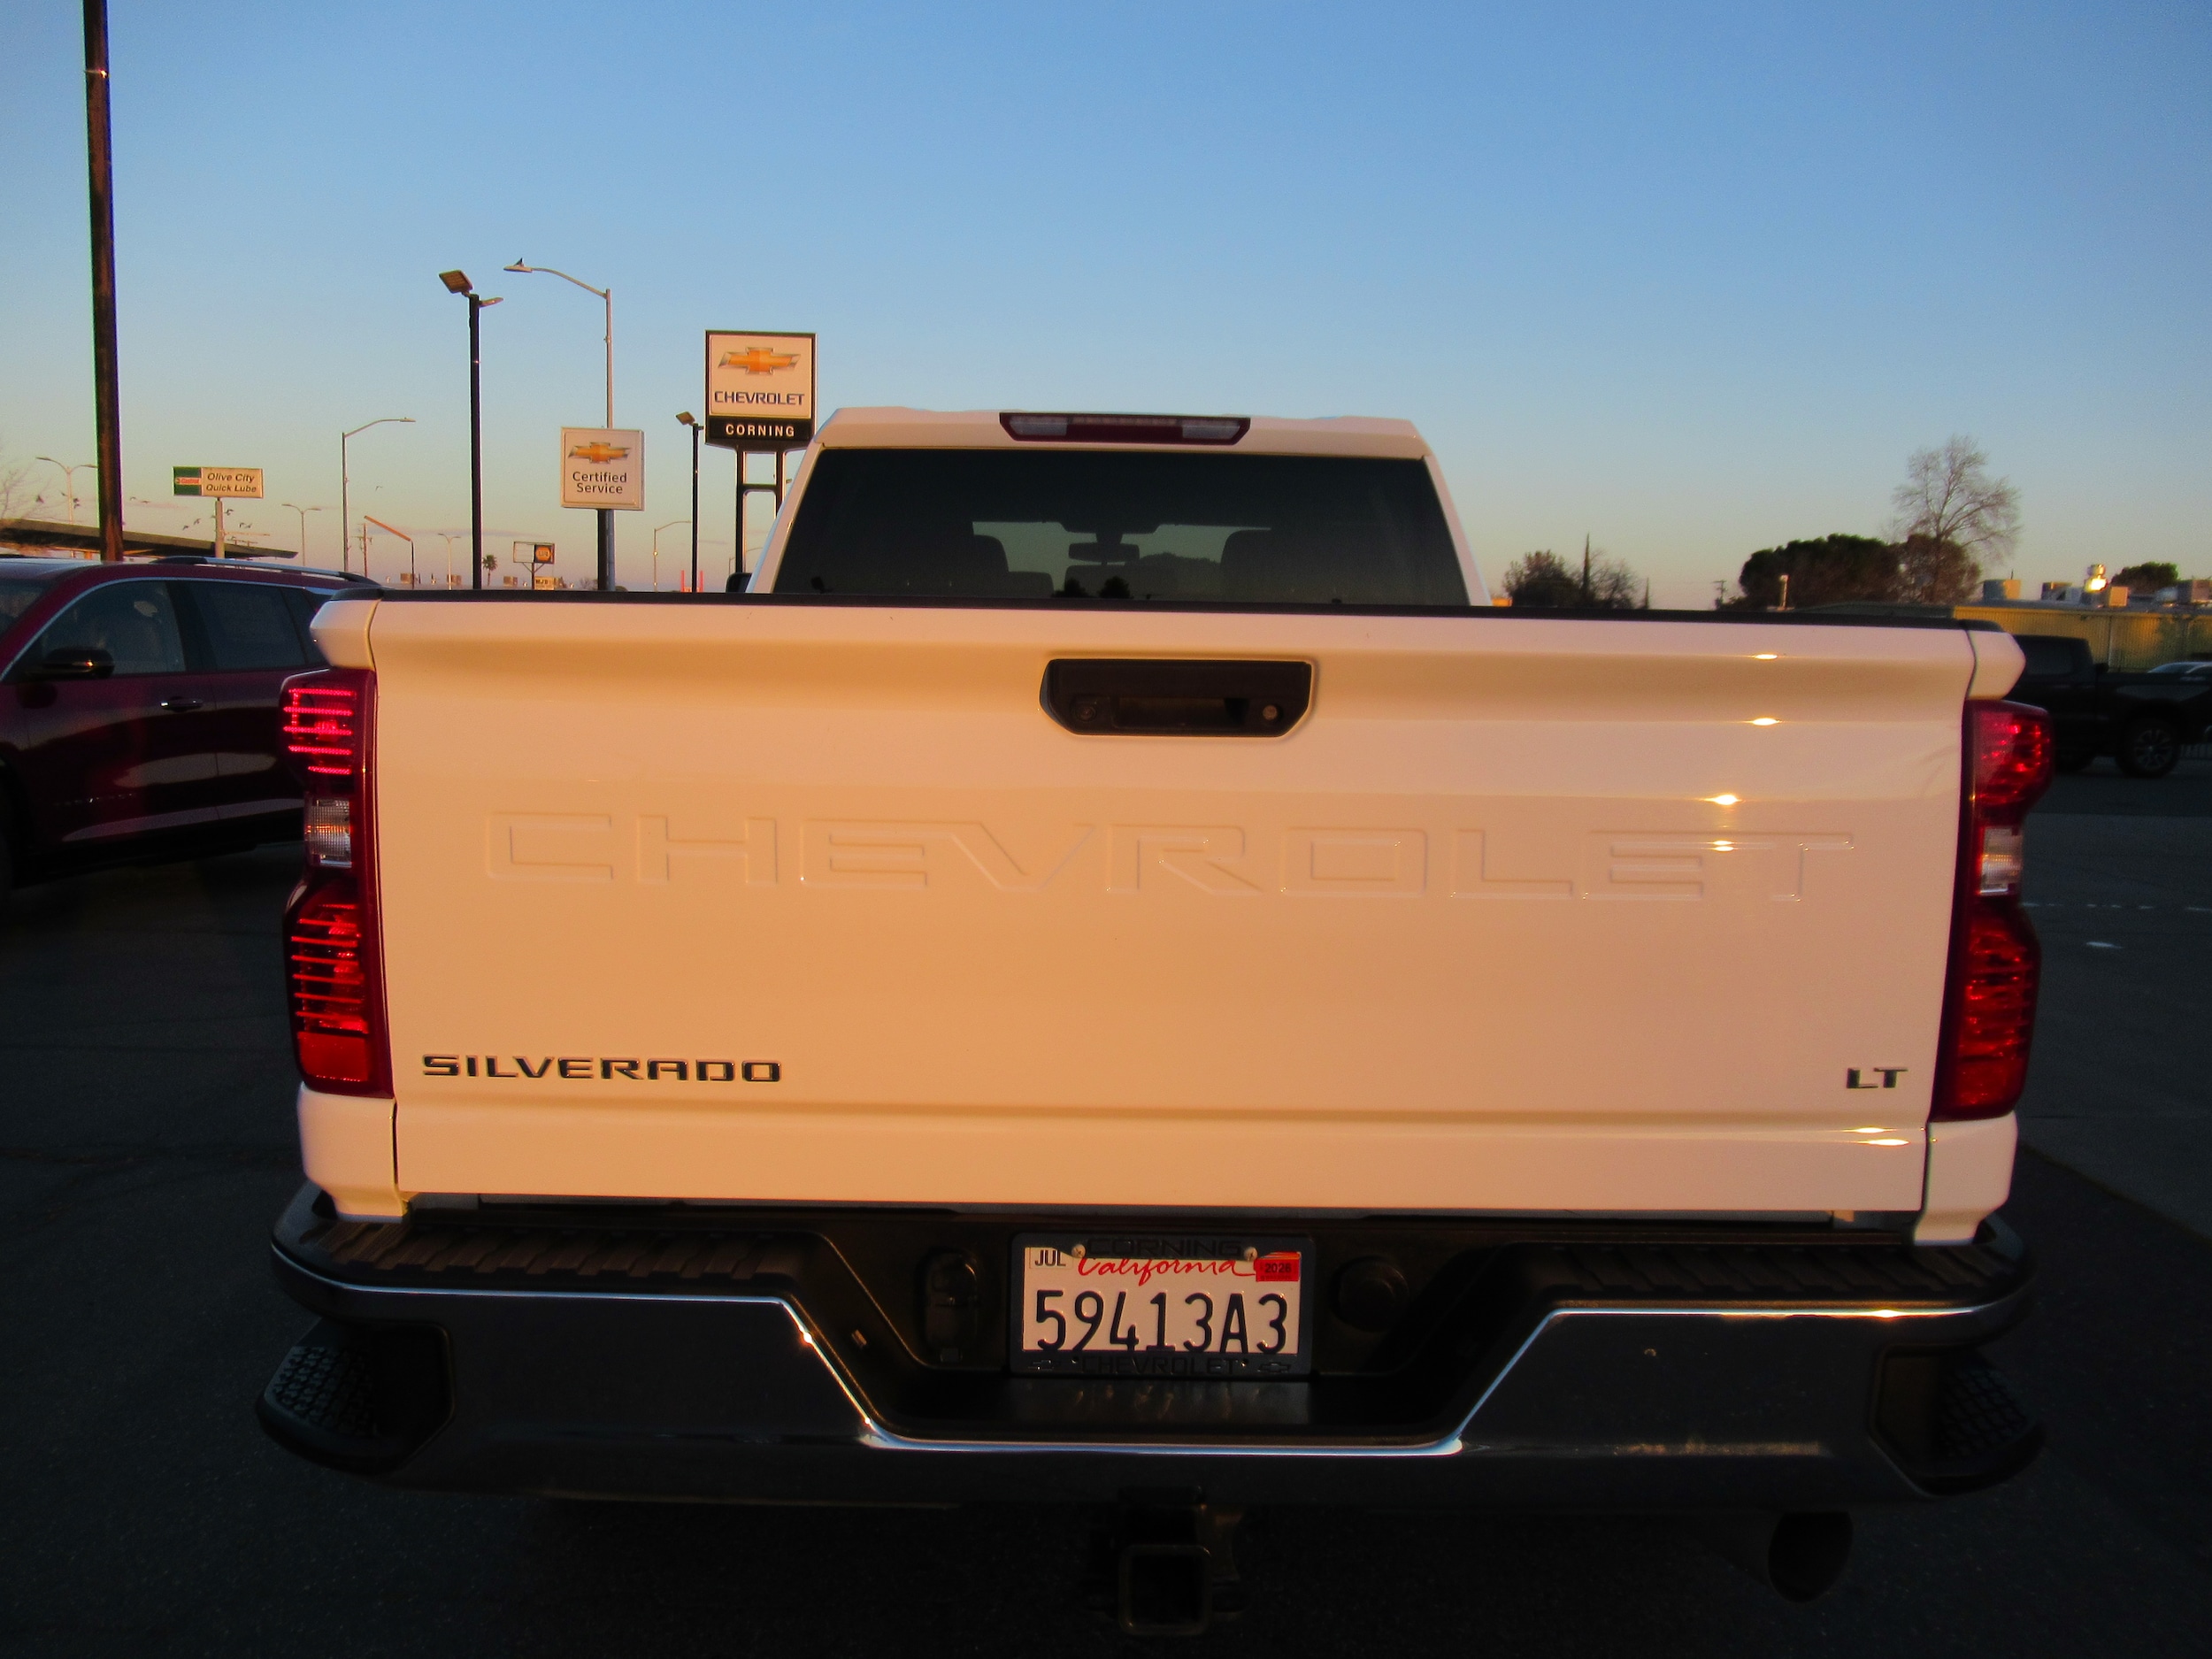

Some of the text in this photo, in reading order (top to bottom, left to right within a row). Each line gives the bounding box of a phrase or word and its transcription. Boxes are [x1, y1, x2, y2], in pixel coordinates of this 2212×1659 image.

[714, 390, 805, 405] CHEVROLET
[725, 423, 795, 437] CORNING
[207, 472, 255, 484] Olive City
[572, 471, 627, 483] Certified
[234, 484, 257, 493] Lube
[576, 482, 623, 494] Service
[484, 811, 1855, 903] CHEVROLET
[422, 1054, 781, 1082] SILVERADO
[1846, 1067, 1909, 1089] LT
[1087, 1239, 1241, 1256] CORNING
[1033, 1250, 1067, 1267] JUL
[1077, 1257, 1257, 1286] California
[1264, 1263, 1292, 1273] 2026
[1036, 1289, 1288, 1354] 59413A3
[1082, 1355, 1238, 1375] CHEVROLET
